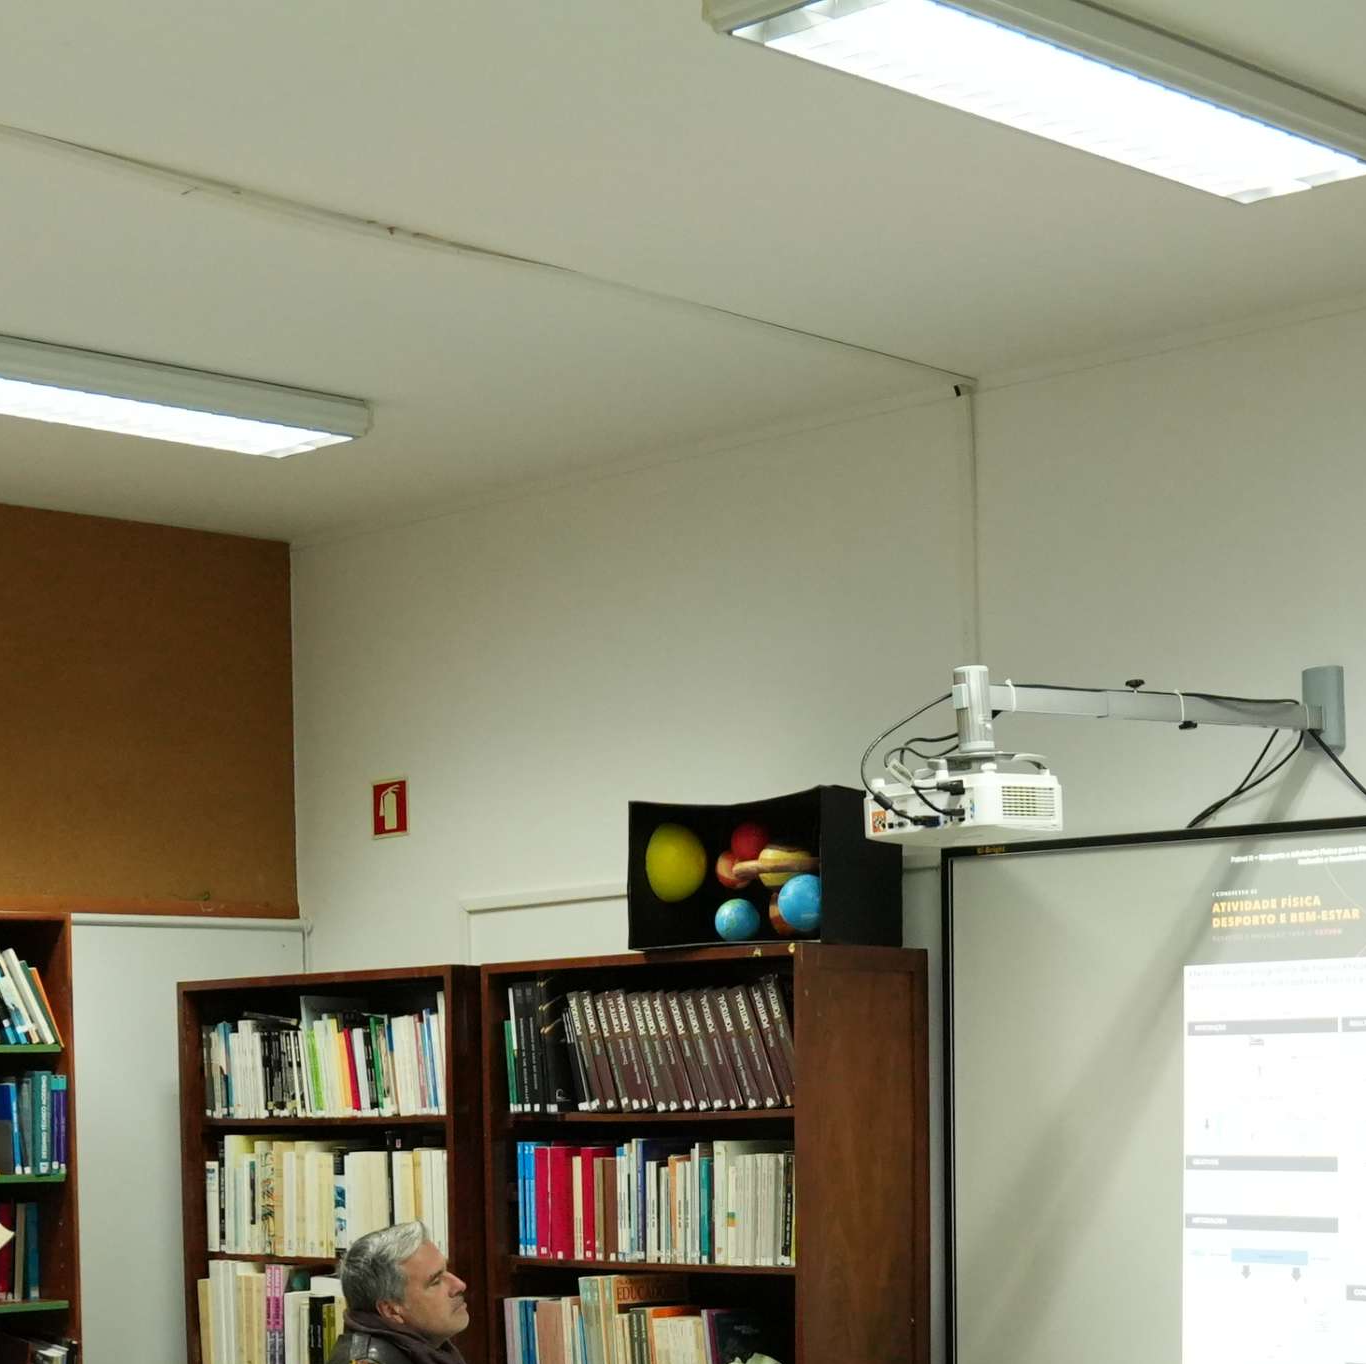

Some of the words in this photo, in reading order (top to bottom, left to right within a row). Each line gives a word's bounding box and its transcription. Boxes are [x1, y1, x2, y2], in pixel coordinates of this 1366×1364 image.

[1212, 897, 1278, 914] ATIVIDADE
[1281, 894, 1321, 909] FÍSICA
[1212, 912, 1276, 929] DESPORTO
[1279, 911, 1286, 924] E
[1290, 908, 1361, 924] BEM-ESTAR
